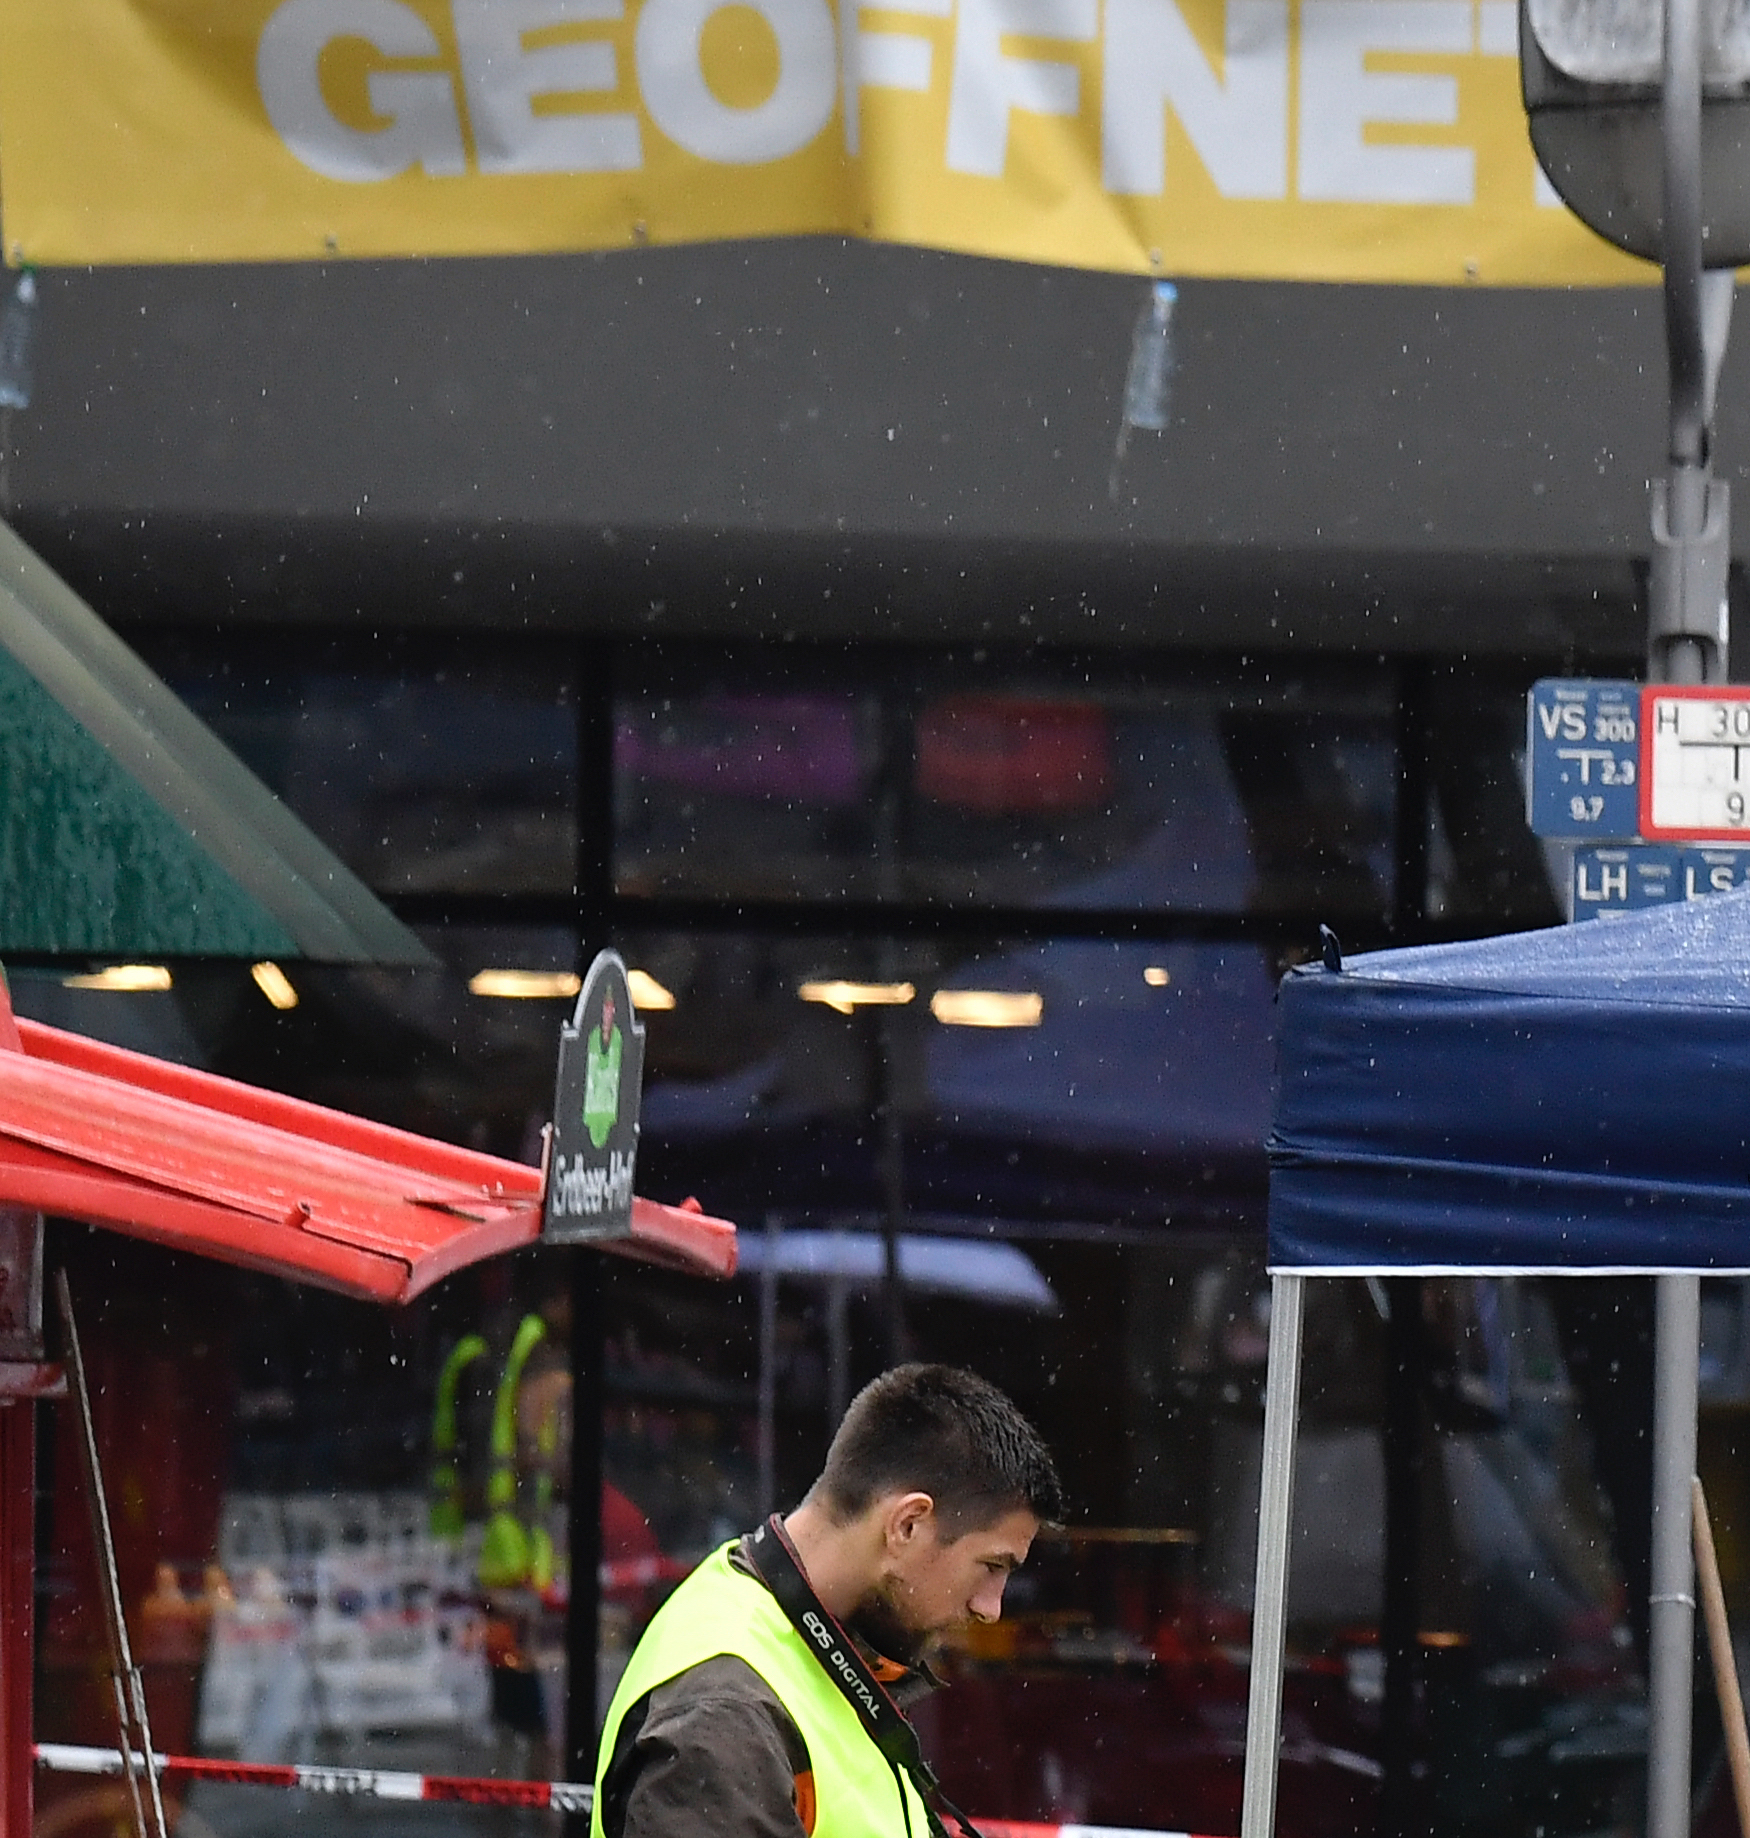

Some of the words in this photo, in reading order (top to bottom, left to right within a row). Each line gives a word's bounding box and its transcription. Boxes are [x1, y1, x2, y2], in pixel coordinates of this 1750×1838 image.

[1539, 702, 1587, 741] VS
[1657, 706, 1679, 736] H
[1577, 864, 1627, 901] LH
[802, 1611, 835, 1650] EOS
[830, 1650, 880, 1720] DIGITAL
